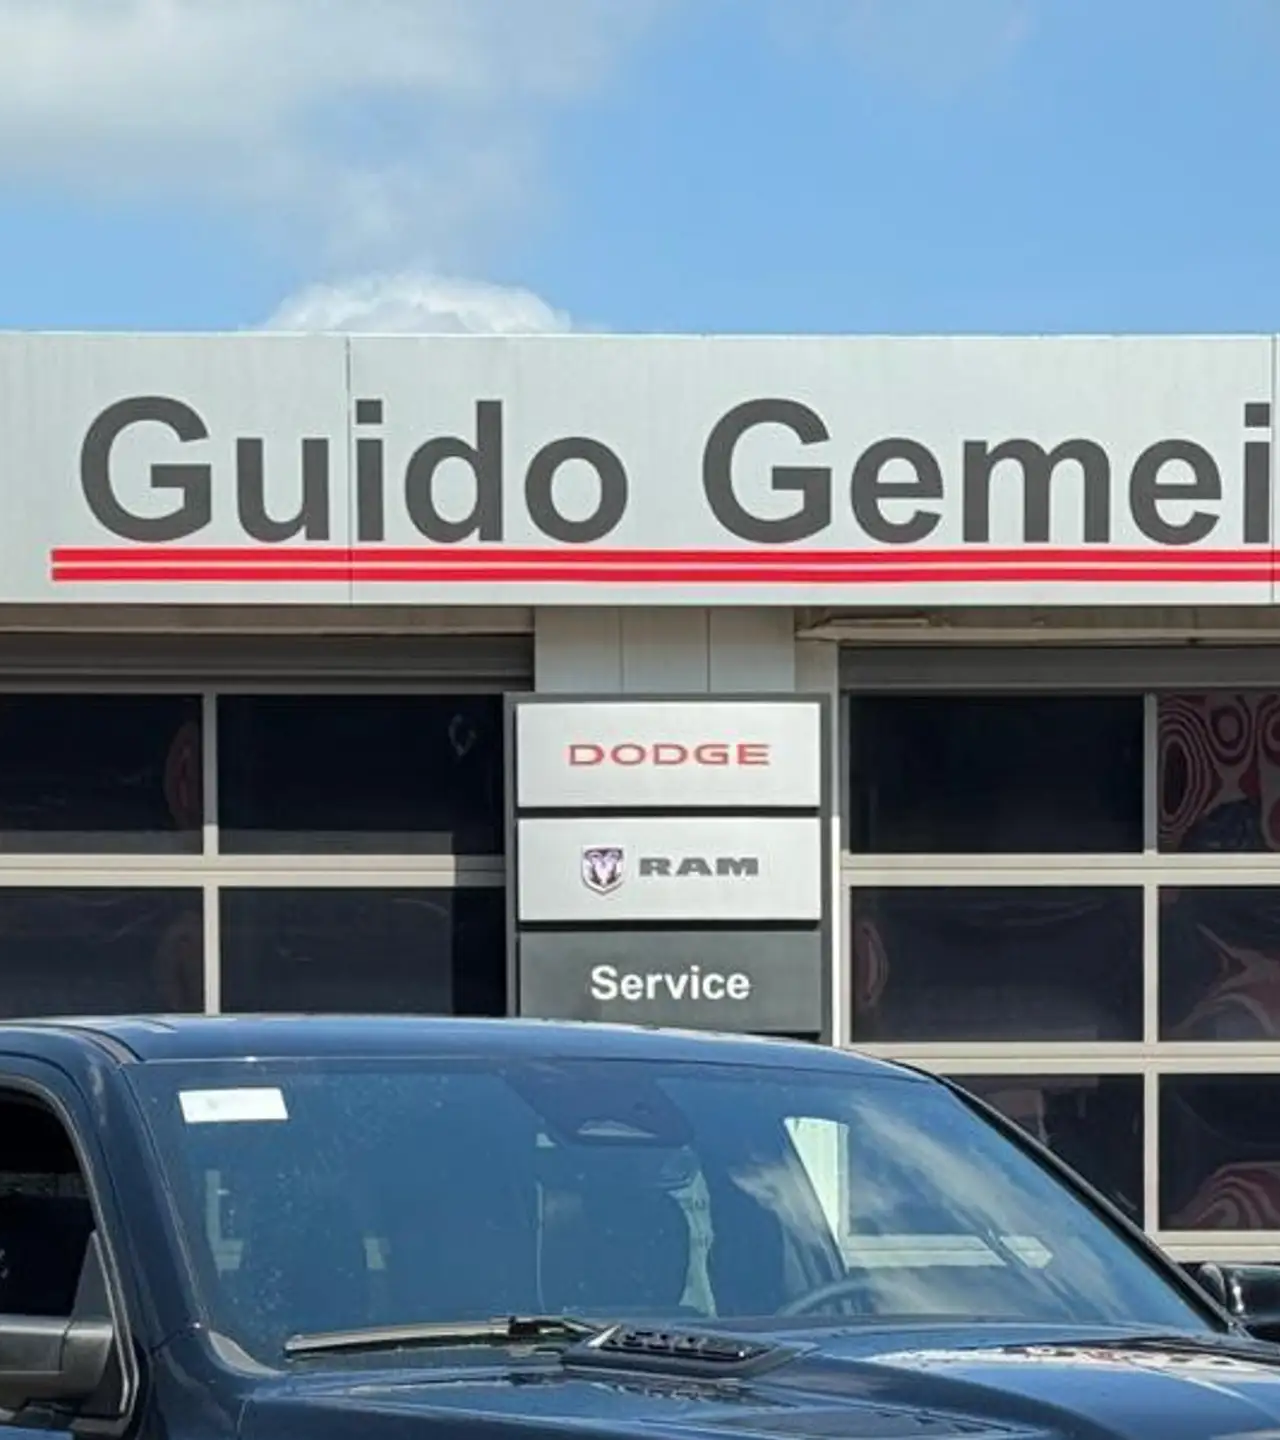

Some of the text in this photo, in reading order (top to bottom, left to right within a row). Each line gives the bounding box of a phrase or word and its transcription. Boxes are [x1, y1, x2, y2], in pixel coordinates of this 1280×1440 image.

[78, 395, 630, 545] Guido
[568, 743, 772, 766] DODGE
[638, 857, 759, 876] RAM
[590, 965, 750, 1001] Service
